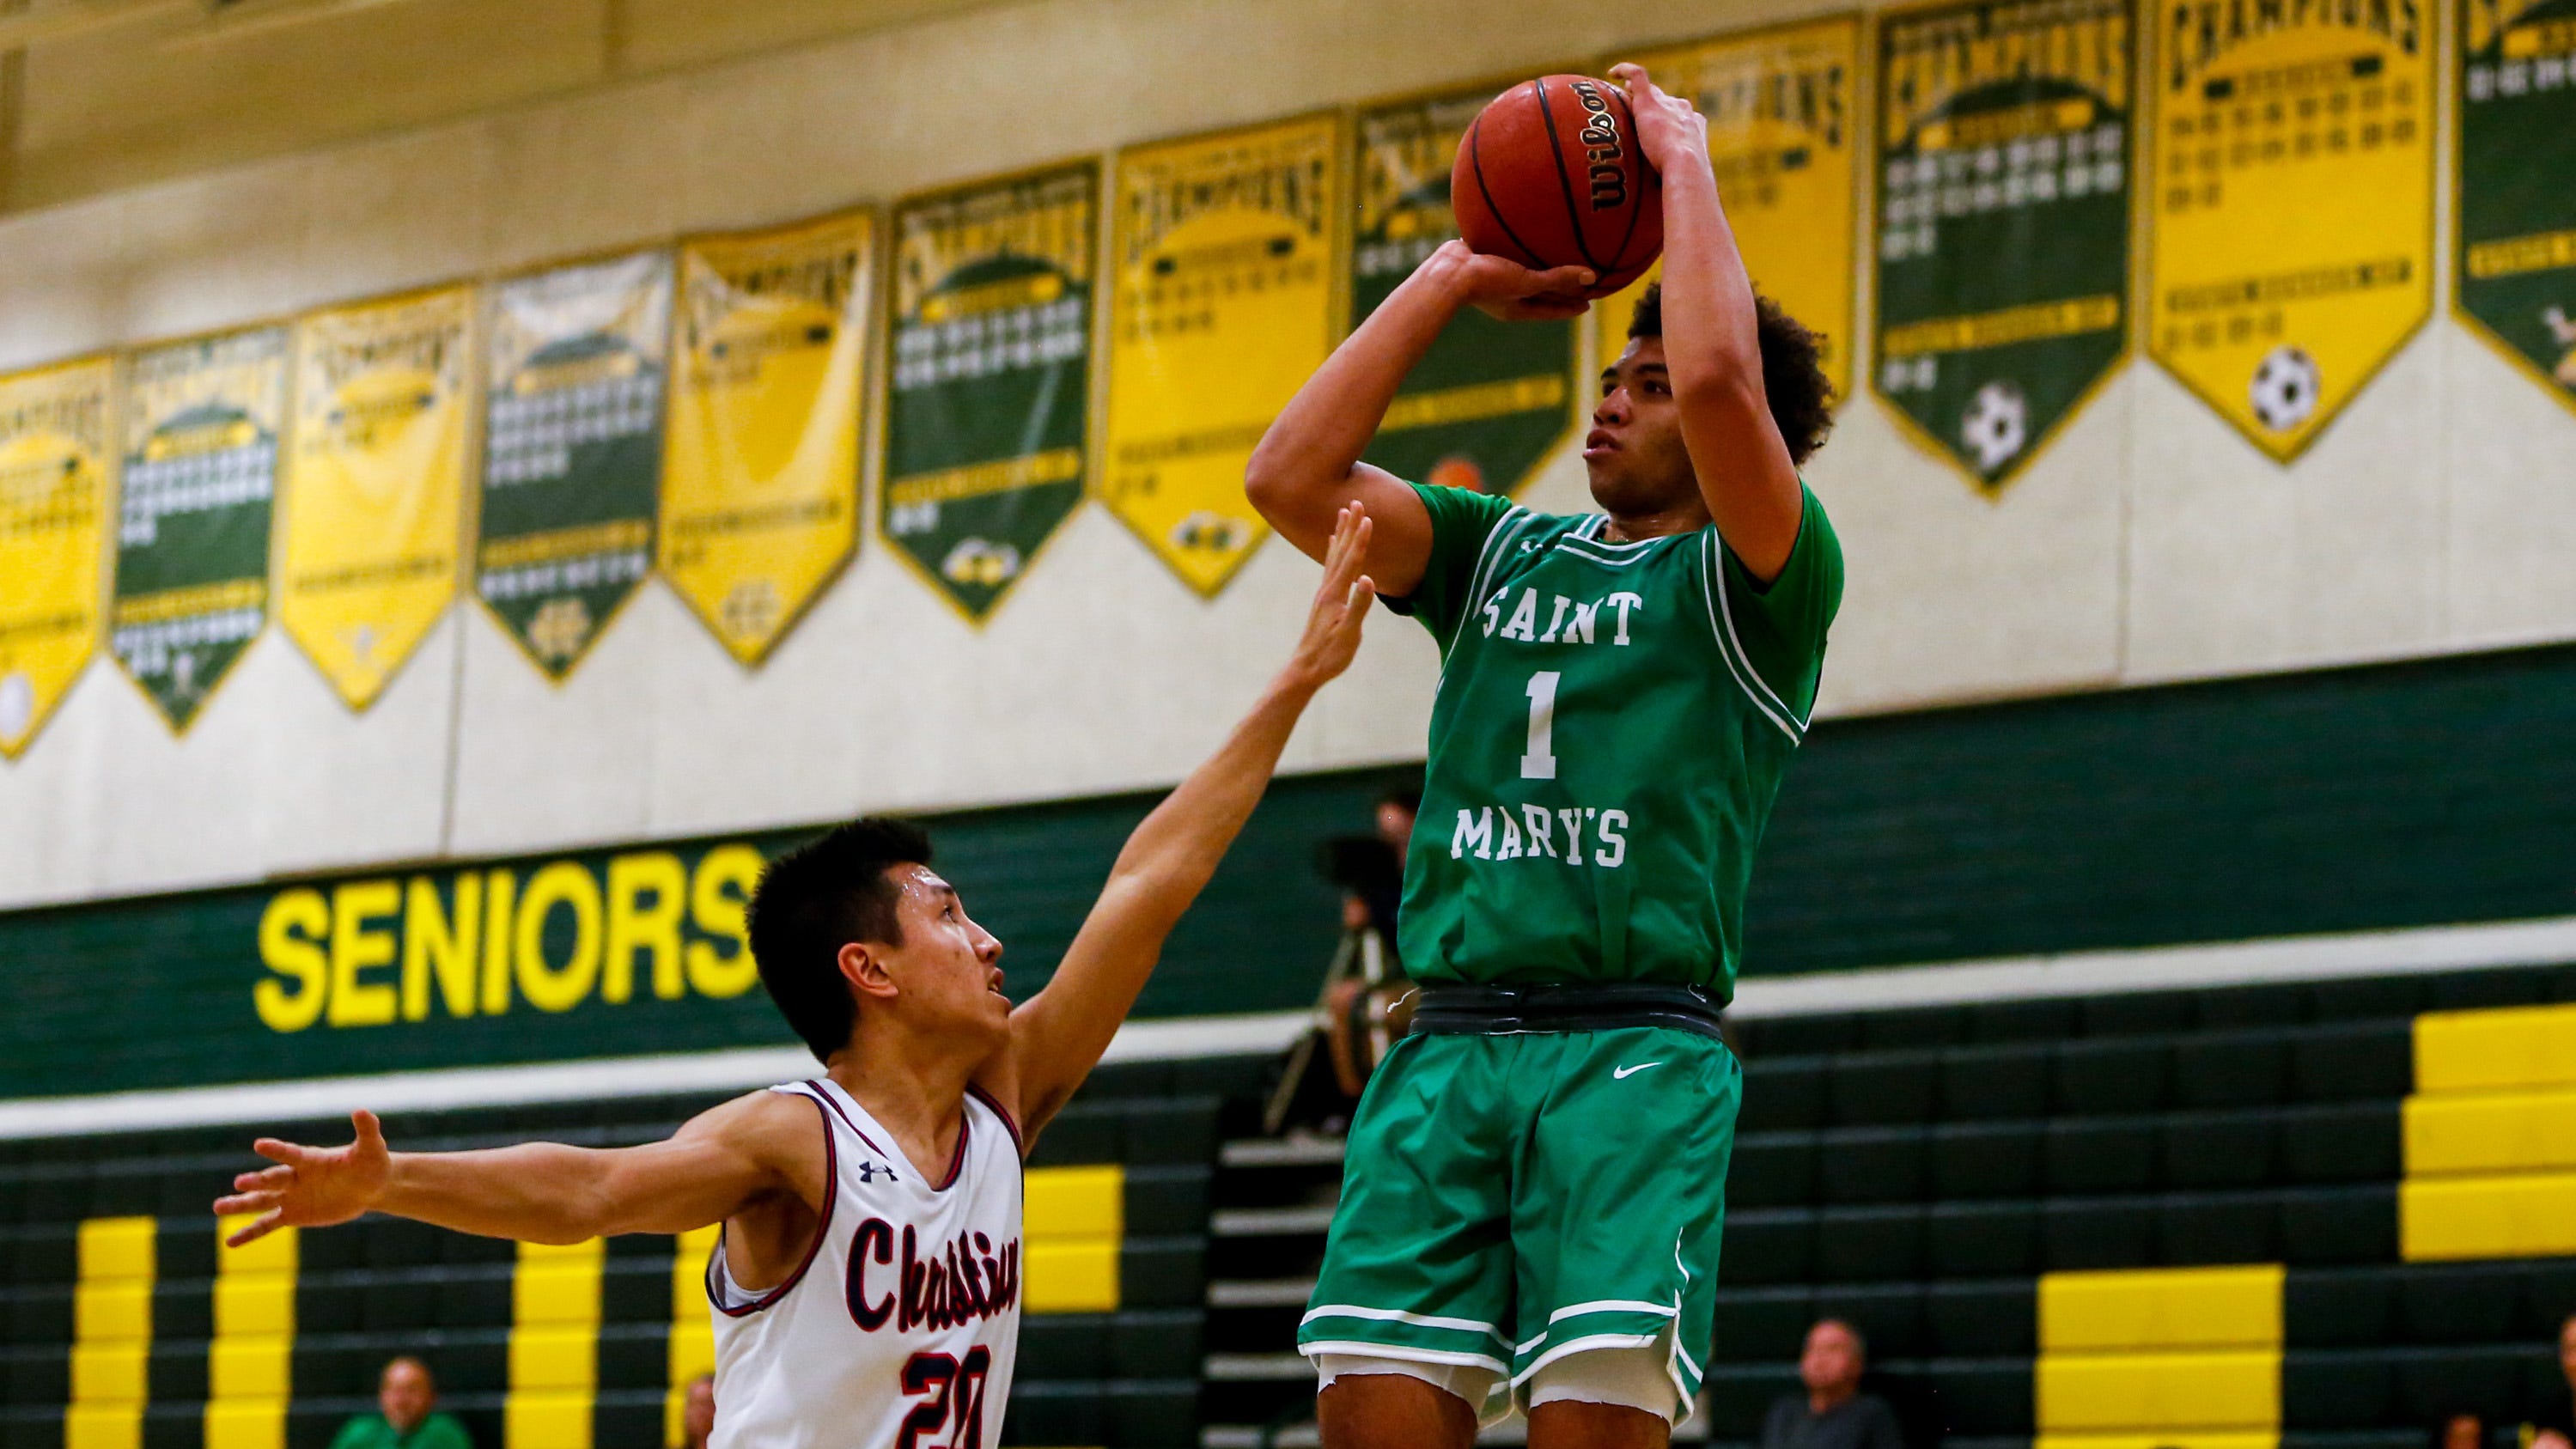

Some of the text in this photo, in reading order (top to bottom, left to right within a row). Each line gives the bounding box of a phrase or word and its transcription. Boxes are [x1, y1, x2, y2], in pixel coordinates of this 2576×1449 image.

[1568, 81, 1628, 213] Wilson
[1483, 587, 1642, 646] SAINT
[1520, 670, 1561, 779] 1
[1450, 803, 1629, 868] MARY'S
[253, 843, 765, 1032] SENIORS
